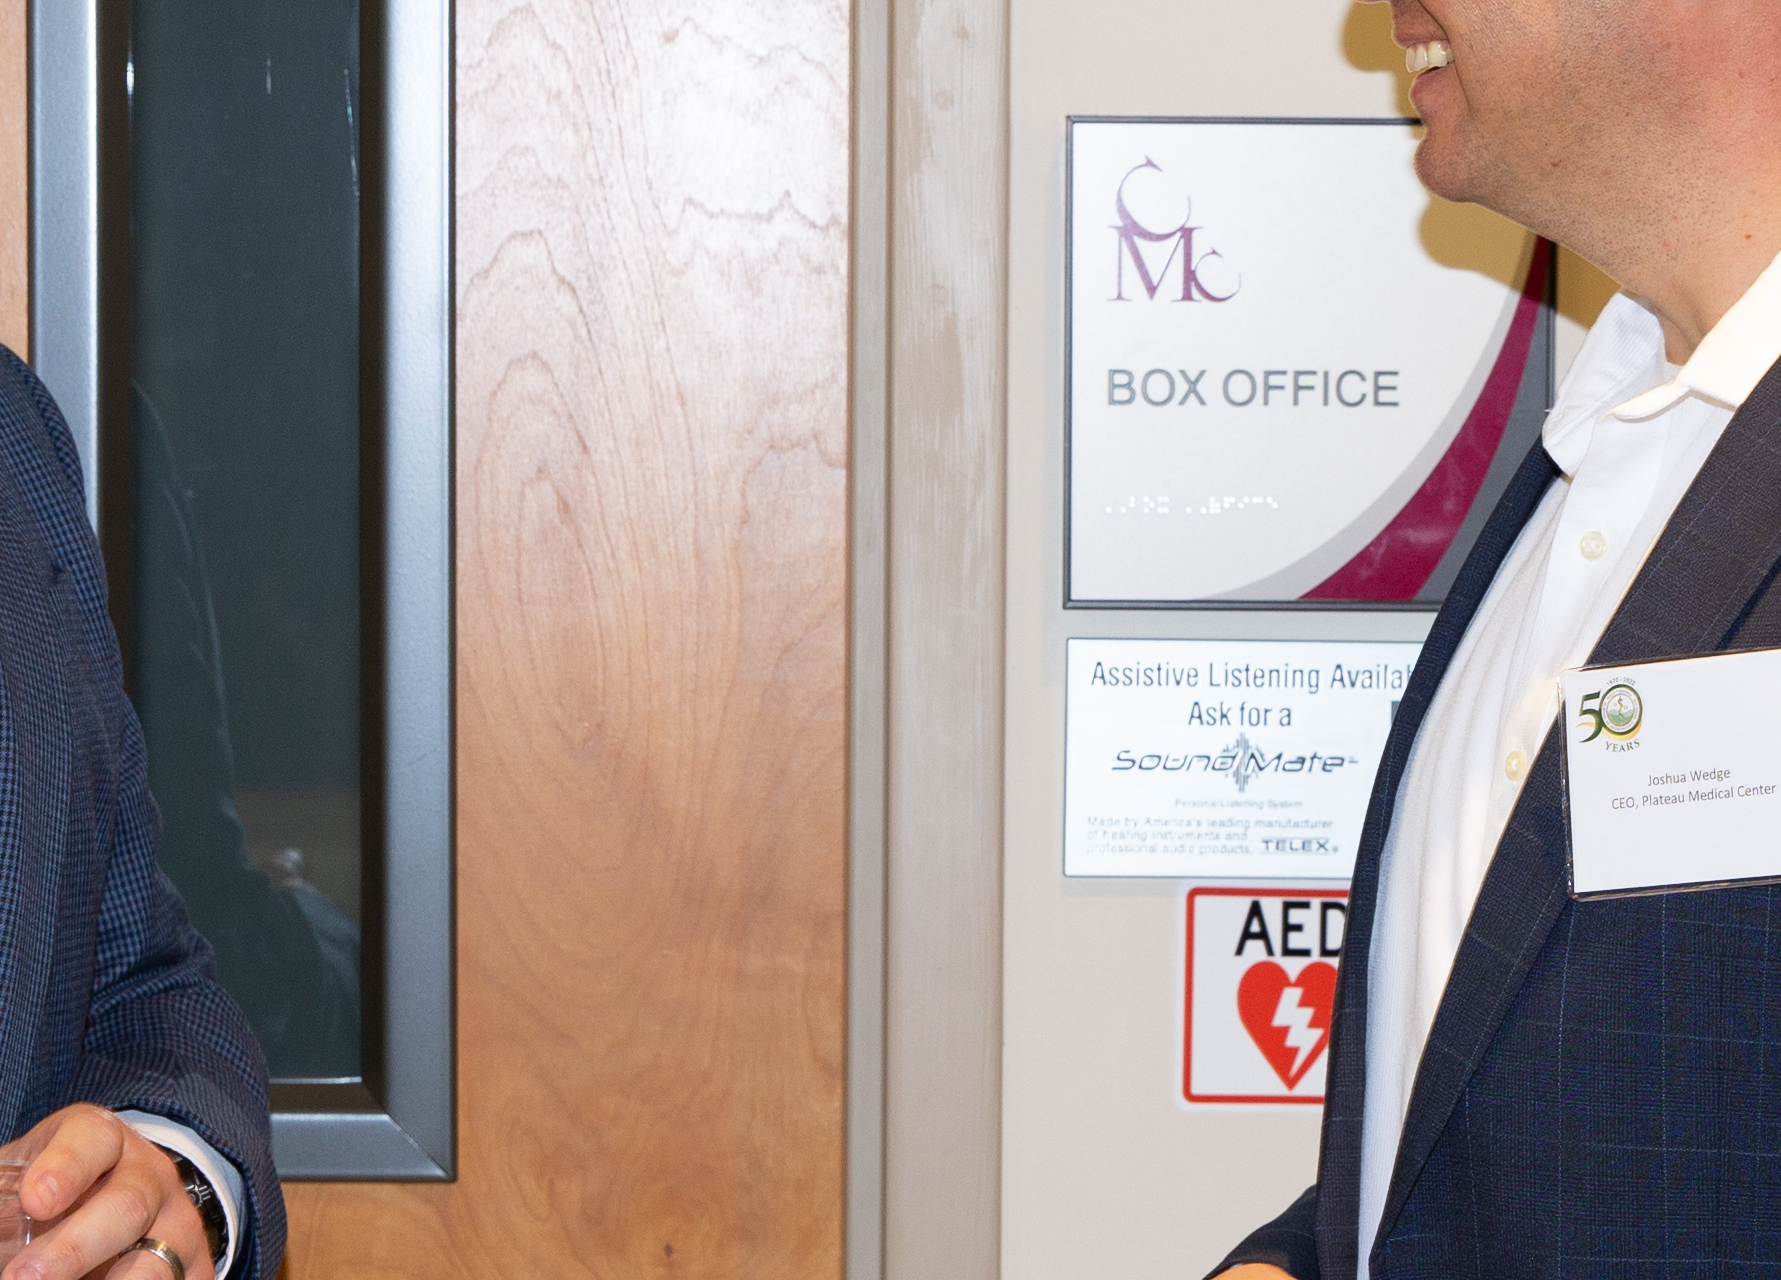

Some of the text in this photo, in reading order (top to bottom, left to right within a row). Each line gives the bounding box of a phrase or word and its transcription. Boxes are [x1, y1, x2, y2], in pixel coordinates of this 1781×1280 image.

[1107, 369, 1400, 407] BOX OFFICE
[1091, 662, 1198, 687] Assistive
[1209, 663, 1319, 694] Listening
[1188, 701, 1292, 727] Ask for a
[1605, 738, 1640, 753] YEARS
[1647, 767, 1731, 787] Joshua Wedge
[1611, 783, 1777, 810] CEO, Plateau Medical Center
[1234, 901, 1347, 957] AED
